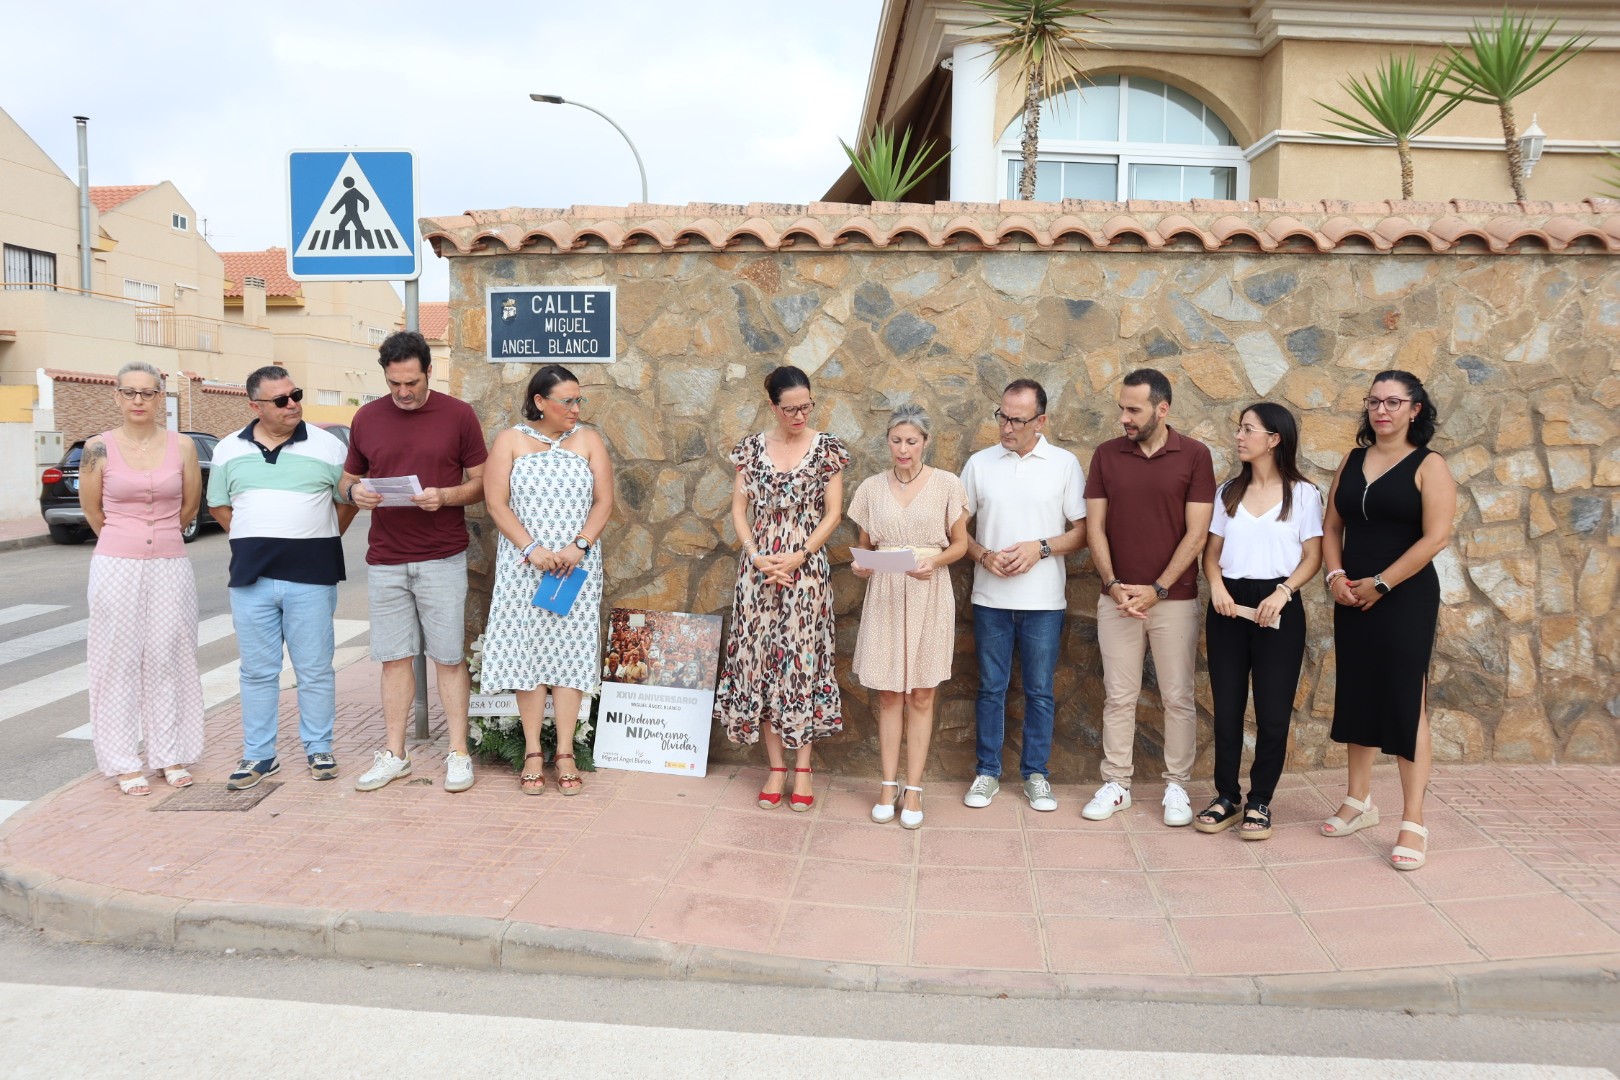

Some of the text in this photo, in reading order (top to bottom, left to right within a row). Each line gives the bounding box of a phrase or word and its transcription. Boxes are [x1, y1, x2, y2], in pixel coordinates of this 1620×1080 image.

[531, 294, 595, 314] CALLE
[544, 317, 591, 333] MIGUEL
[501, 338, 598, 355] ANGEL BLANCO
[469, 701, 485, 709] ESA
[488, 700, 494, 709] Y
[616, 690, 698, 705] XXVI ANIVERSARIO
[606, 711, 667, 729] NI Podemos
[625, 726, 691, 742] NI Queremos
[661, 739, 698, 753] Olvidar
